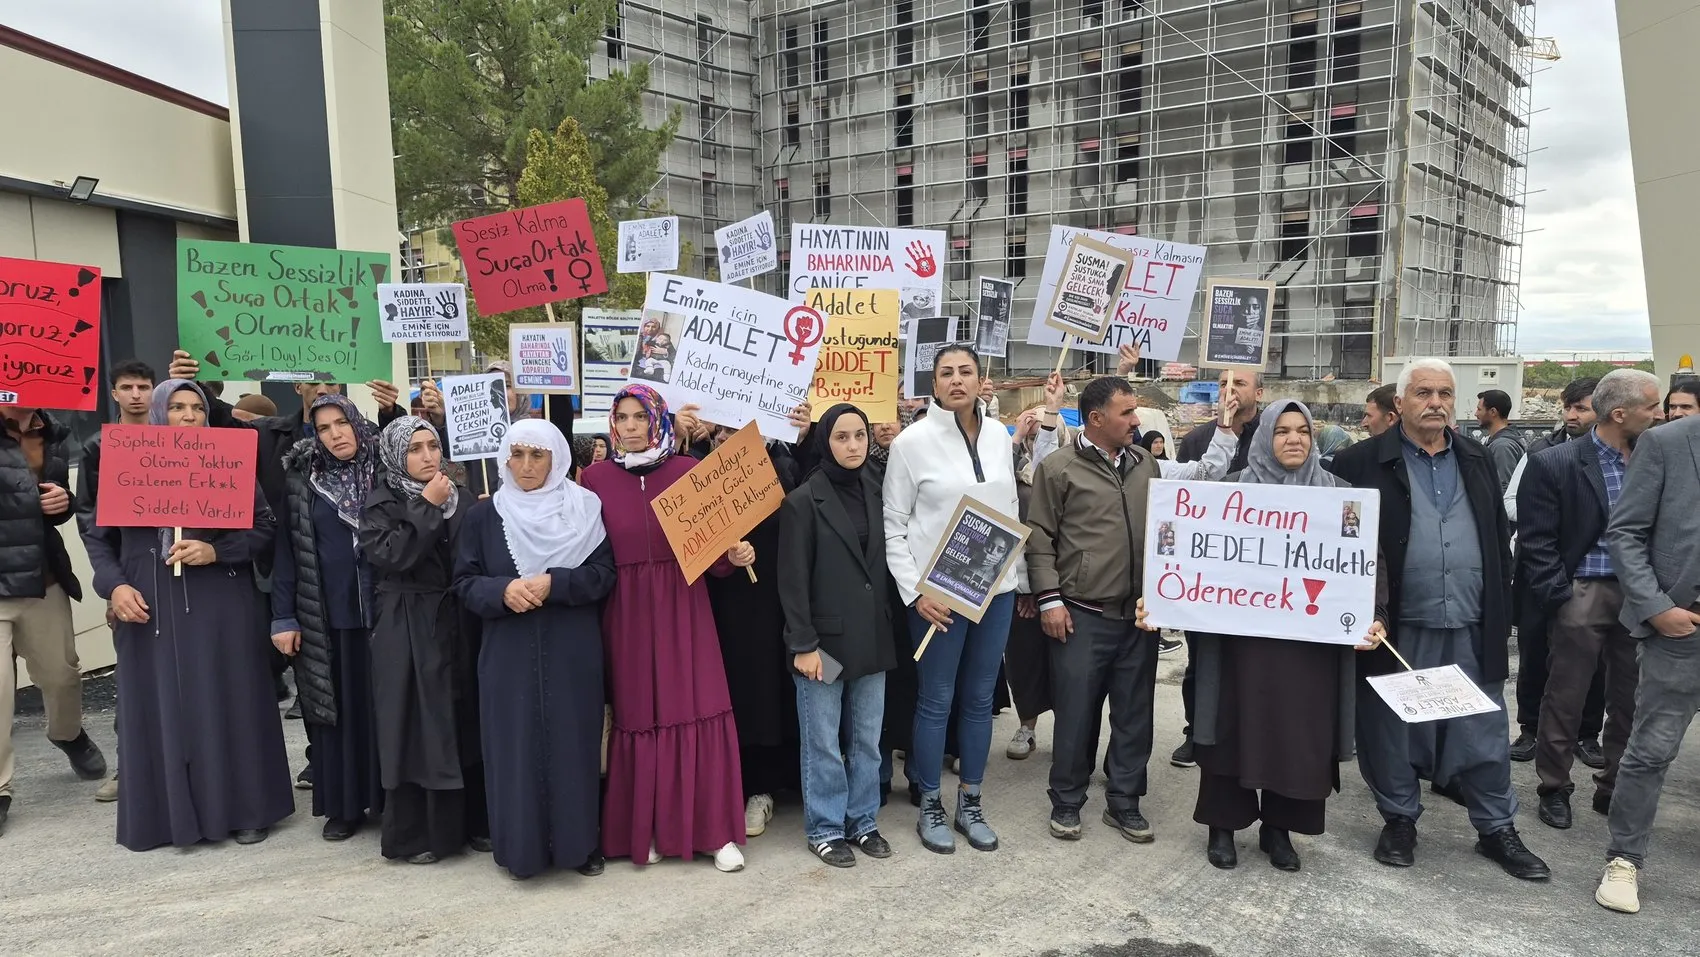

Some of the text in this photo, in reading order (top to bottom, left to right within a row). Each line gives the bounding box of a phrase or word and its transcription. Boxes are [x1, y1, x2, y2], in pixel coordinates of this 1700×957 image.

[461, 209, 568, 244] Sesiz Kalma
[726, 226, 748, 240] KADINA
[732, 239, 757, 256] HAYIR!
[800, 229, 889, 250] HAYATININ
[476, 230, 592, 276] Suça Ortak
[808, 254, 894, 272] BAHARINDA
[1076, 253, 1110, 272] SUSMA!
[1154, 243, 1203, 264] Kalmasın
[187, 248, 368, 288] Bazen Sessizlik
[734, 259, 754, 270] EMİNE
[1074, 264, 1106, 279] SUSTUKÇA
[503, 269, 558, 298] Olma!
[726, 270, 749, 280] ADALET
[1070, 272, 1105, 287] SIRA SANA
[1124, 261, 1185, 296] LET
[214, 280, 341, 314] Suça Ortak
[394, 290, 424, 298] KADINA
[1066, 281, 1105, 298] GELECEK!
[1214, 290, 1234, 298] BAZEN
[396, 298, 432, 306] ŞİDDETTE
[662, 279, 758, 324] Emine için
[812, 292, 879, 315] Adalet
[1214, 297, 1242, 306] SESSİZLİK
[400, 306, 435, 318] HAYIR!
[1114, 300, 1168, 332] Kalma
[0, 322, 70, 347] oruz,
[234, 312, 361, 348] Olmaktır!
[424, 330, 462, 338] İSTİYORUZ!
[522, 334, 546, 342] HAYATIN
[684, 315, 788, 362] ADALET
[822, 327, 899, 350] ustuğunda
[686, 350, 810, 400] Kadın cinayetine son!
[450, 381, 486, 397] ADALET
[676, 370, 715, 394] Adalet
[718, 386, 752, 404] yerini
[816, 372, 874, 402] Büyür!
[452, 400, 488, 415] KATİLLER
[454, 408, 490, 423] CEZASINI
[457, 416, 492, 432] ÇEKSİN!
[108, 429, 216, 451] Şüpheli Kadın
[140, 452, 243, 469] Ölümü Yoktur
[118, 472, 182, 486] Gizlenen
[658, 445, 750, 517] Biz Buradayız
[678, 457, 768, 533] Sesimiz Güçlü ve
[196, 500, 245, 519] Vardır
[682, 477, 780, 562] ADALETİ Bekliyoruz
[1174, 488, 1308, 533] Bu Acının
[958, 524, 988, 545] SUSTUKÇA
[962, 514, 992, 537] SUSMA
[949, 541, 970, 555] SANA
[953, 532, 970, 546] SIRA
[945, 546, 972, 566] GELECEK
[1292, 541, 1376, 576] Adaletle
[1418, 696, 1458, 710] ADALET
